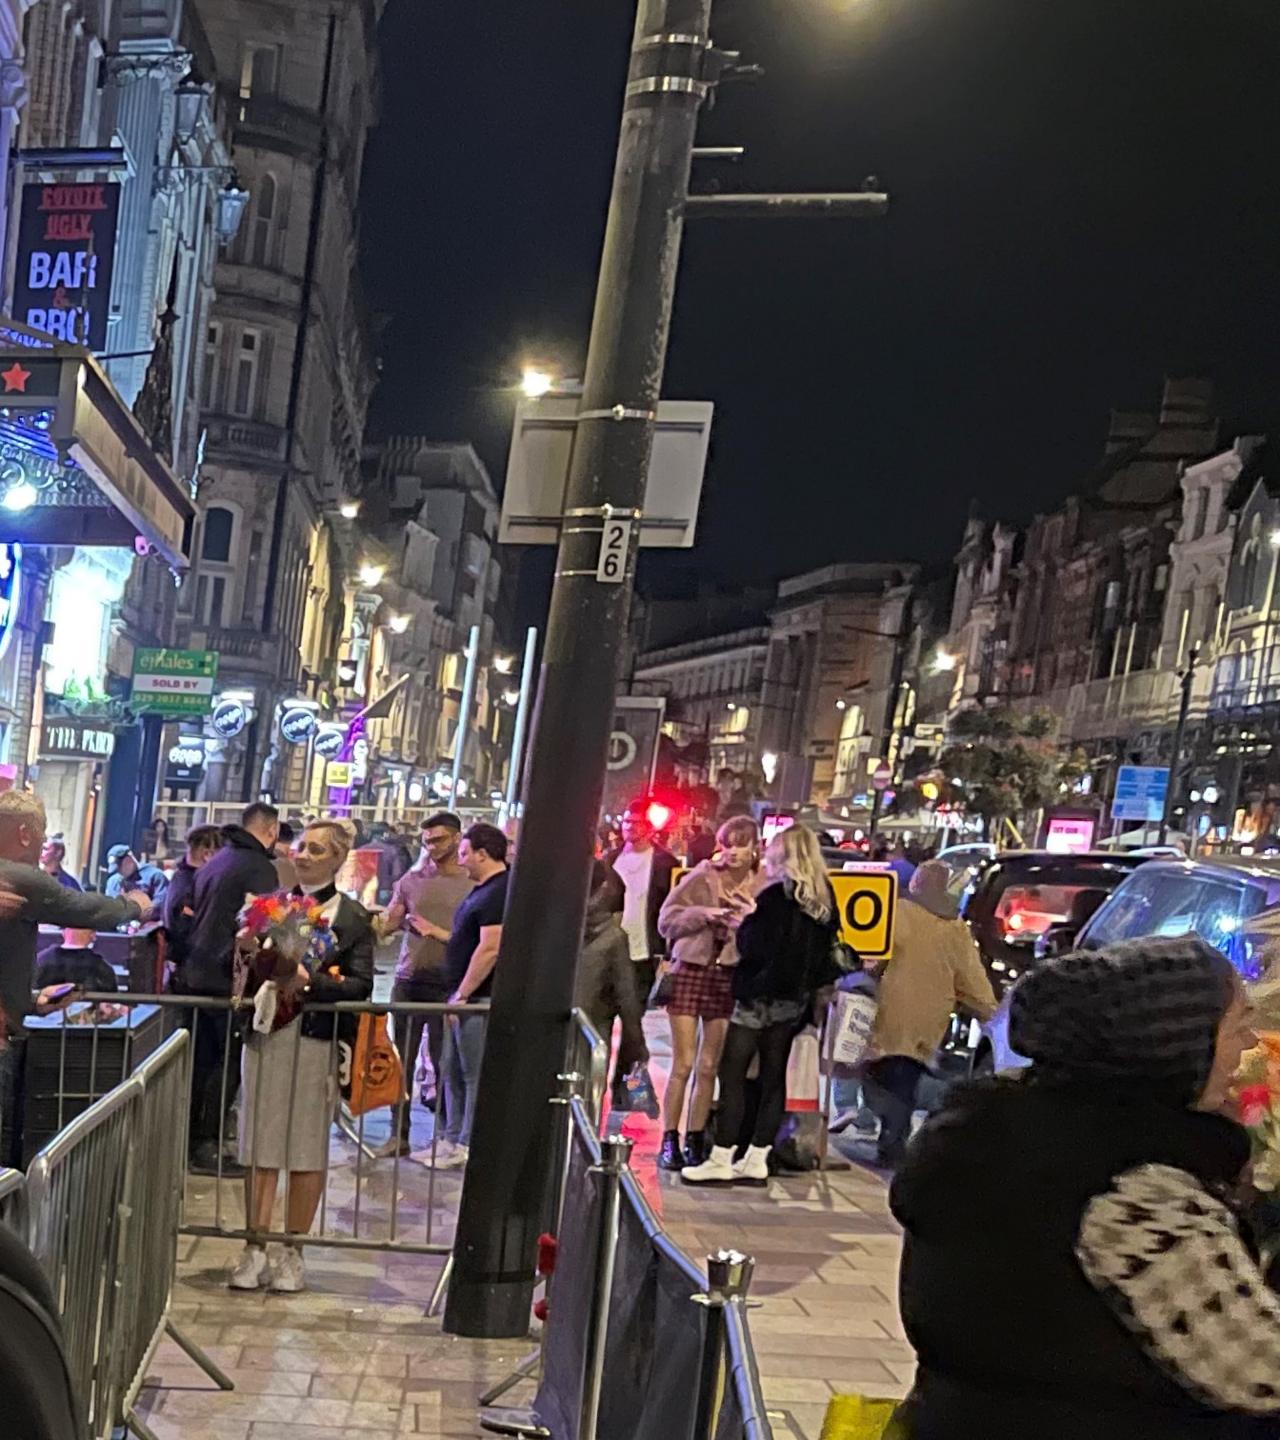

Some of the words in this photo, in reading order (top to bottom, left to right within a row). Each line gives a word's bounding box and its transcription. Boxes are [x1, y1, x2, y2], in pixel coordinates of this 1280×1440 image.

[41, 187, 105, 208] COYOTE
[47, 214, 92, 239] UGLY
[28, 252, 97, 288] BAR
[152, 679, 180, 688] SOLD
[184, 681, 199, 689] BY
